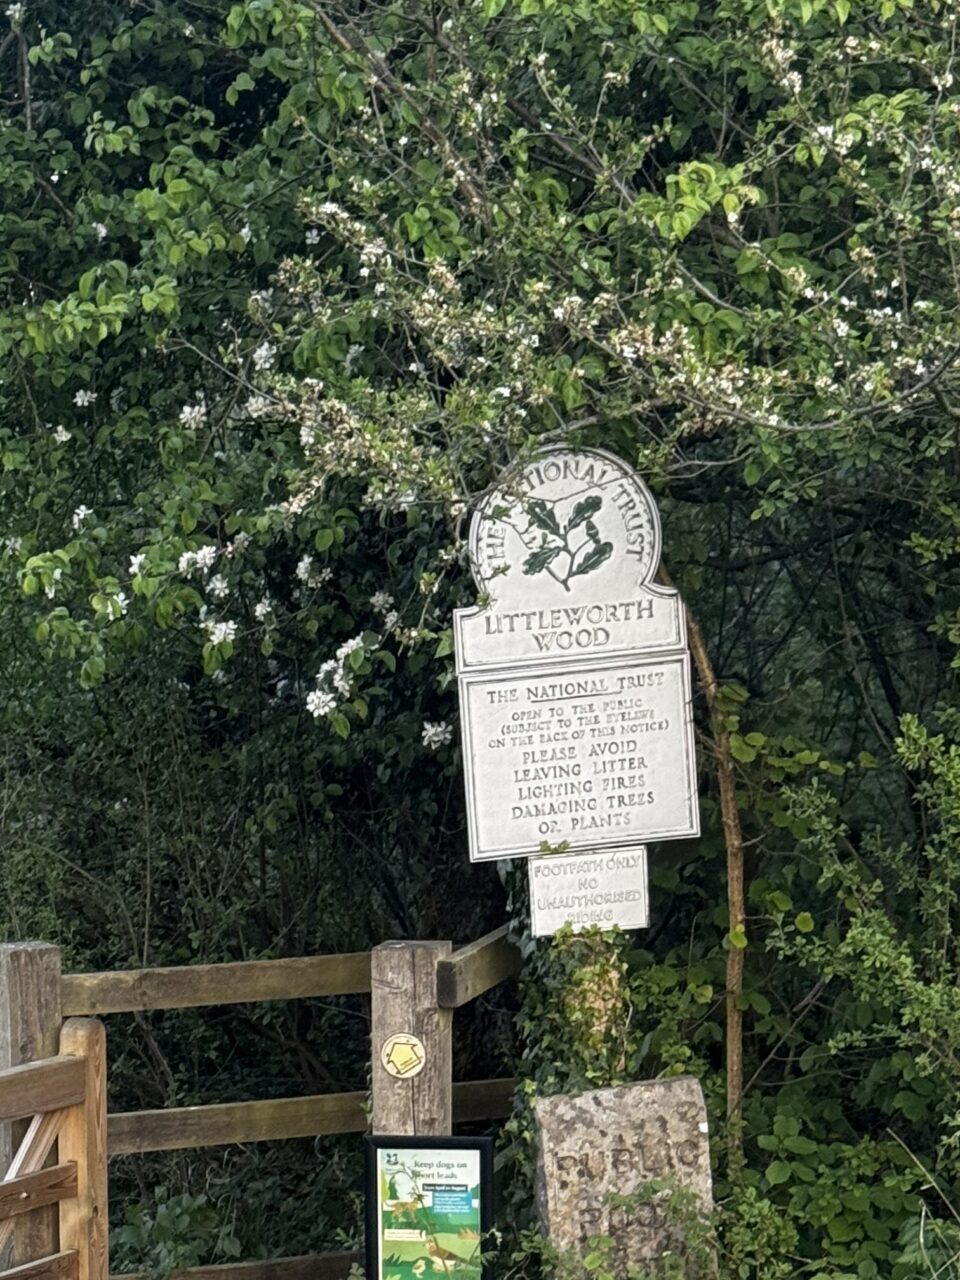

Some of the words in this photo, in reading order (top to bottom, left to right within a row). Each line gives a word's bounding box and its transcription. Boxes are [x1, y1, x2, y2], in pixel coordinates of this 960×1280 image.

[611, 483, 646, 563] TRUST
[484, 599, 655, 635] LITTLEWORTH
[532, 627, 611, 652] WOOD
[486, 690, 519, 704] THE
[527, 679, 609, 701] NATIONAL
[617, 672, 665, 691] TRUST
[511, 708, 542, 722] OPEN
[549, 706, 565, 718] TO
[572, 703, 595, 716] THE
[603, 698, 643, 712] PUBLIC
[488, 737, 506, 749] ON
[511, 734, 535, 747] THE
[540, 730, 569, 744] BACK
[571, 728, 586, 741] OF
[590, 726, 616, 739] THIS
[621, 719, 670, 736] NOTICE)
[501, 720, 552, 736] (SUBJECT
[557, 718, 573, 729] TO
[577, 715, 601, 727] THE
[523, 746, 577, 765] PLEASE
[589, 739, 638, 758] AVOID
[514, 763, 582, 783] LEAVING
[593, 757, 648, 775] LITTER
[518, 780, 593, 801] LIGHTING
[602, 774, 646, 792] FIRES
[511, 797, 597, 820] DAMAGING
[607, 791, 655, 808] TREES
[538, 820, 561, 834] OR
[571, 812, 632, 831] PLANTS
[534, 859, 603, 878] FOOTPATH
[606, 855, 641, 871] ONLY
[578, 878, 599, 891] NO
[414, 1161, 434, 1169] Keep
[436, 1161, 454, 1170] dogs
